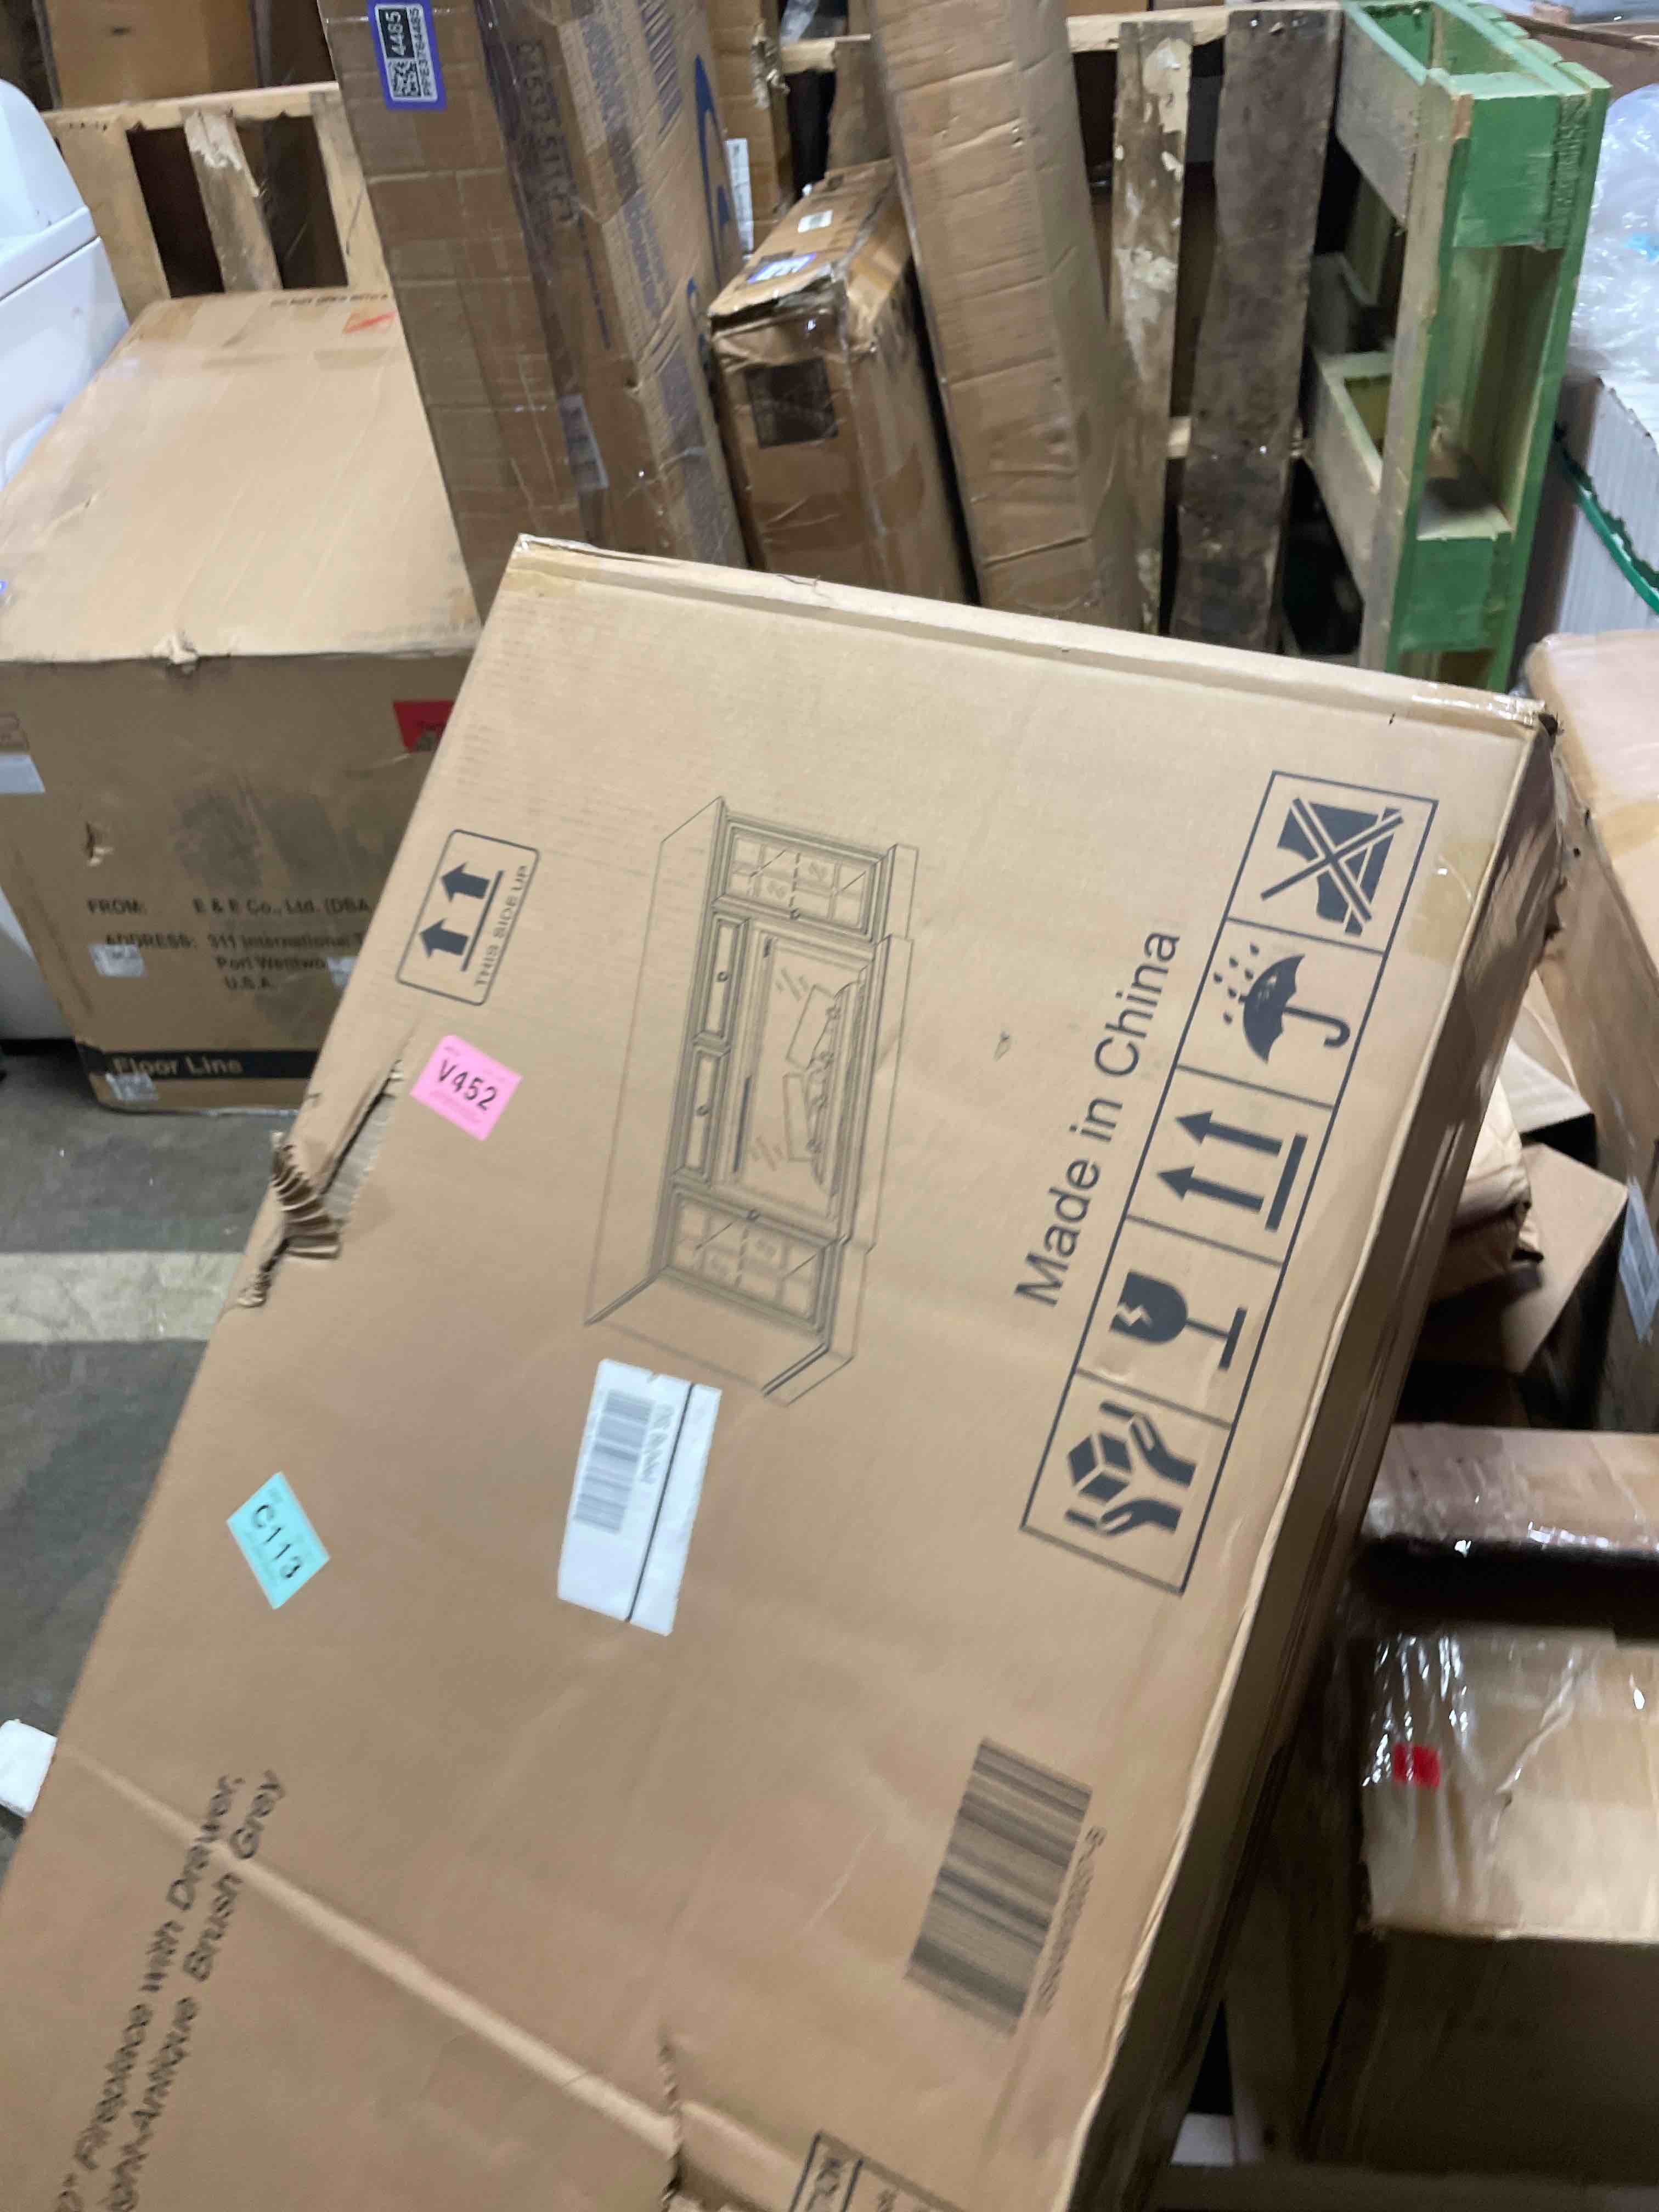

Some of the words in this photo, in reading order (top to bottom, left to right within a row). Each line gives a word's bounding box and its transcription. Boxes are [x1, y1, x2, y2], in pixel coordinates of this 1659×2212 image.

[385, 11, 407, 56] 4485
[474, 944, 499, 986] THIS
[492, 895, 518, 939] SIDE
[511, 865, 528, 891] UP
[1093, 930, 1181, 1077] China
[184, 1054, 244, 1075] Line
[438, 1058, 498, 1111] V452
[1069, 1096, 1124, 1143] in
[1013, 1159, 1102, 1308] Made
[182, 1871, 245, 1983] Brush
[74, 2003, 154, 2171] Fireplace
[138, 1920, 185, 1993] with
